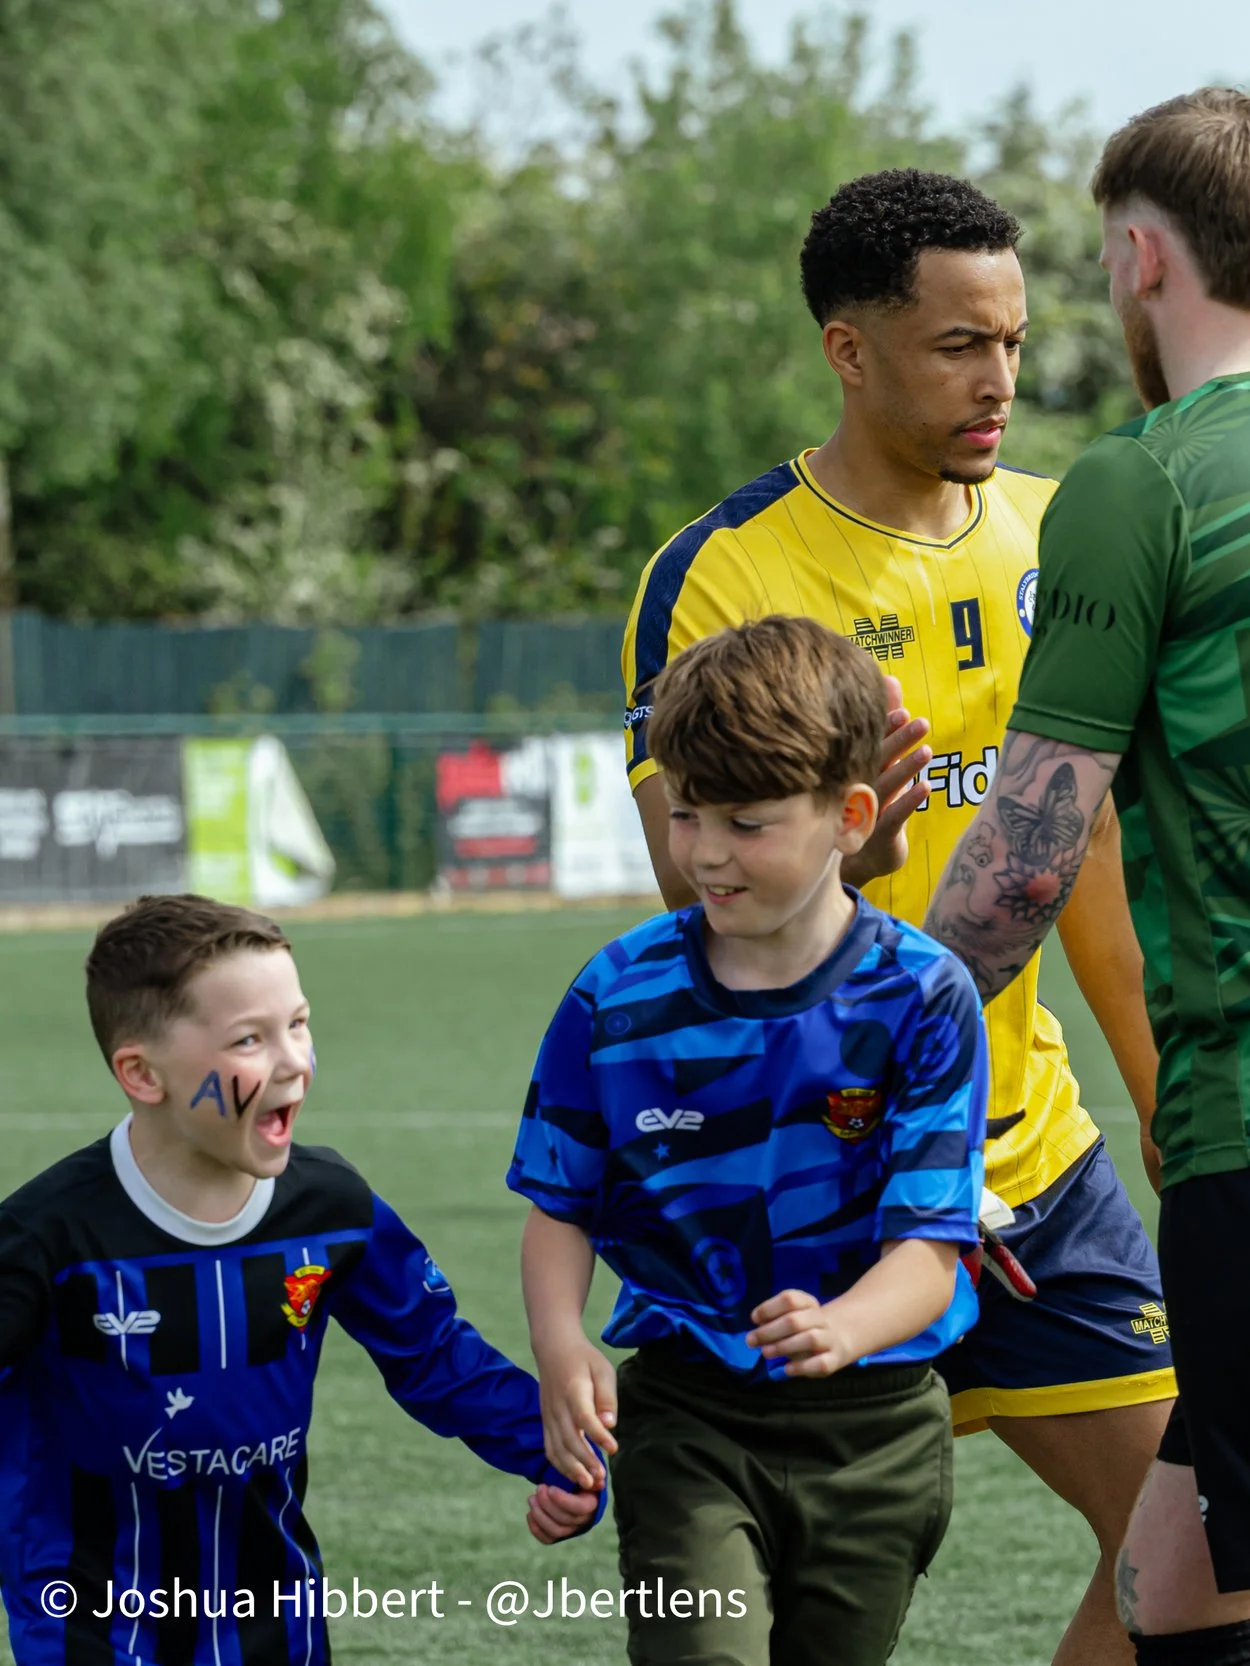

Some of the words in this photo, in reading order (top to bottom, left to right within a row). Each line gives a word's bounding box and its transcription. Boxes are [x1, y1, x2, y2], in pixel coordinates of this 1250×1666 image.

[950, 597, 986, 671] 9
[914, 745, 999, 812] Fid
[189, 1069, 262, 1122] AV
[122, 1426, 302, 1480] VESTACARE
